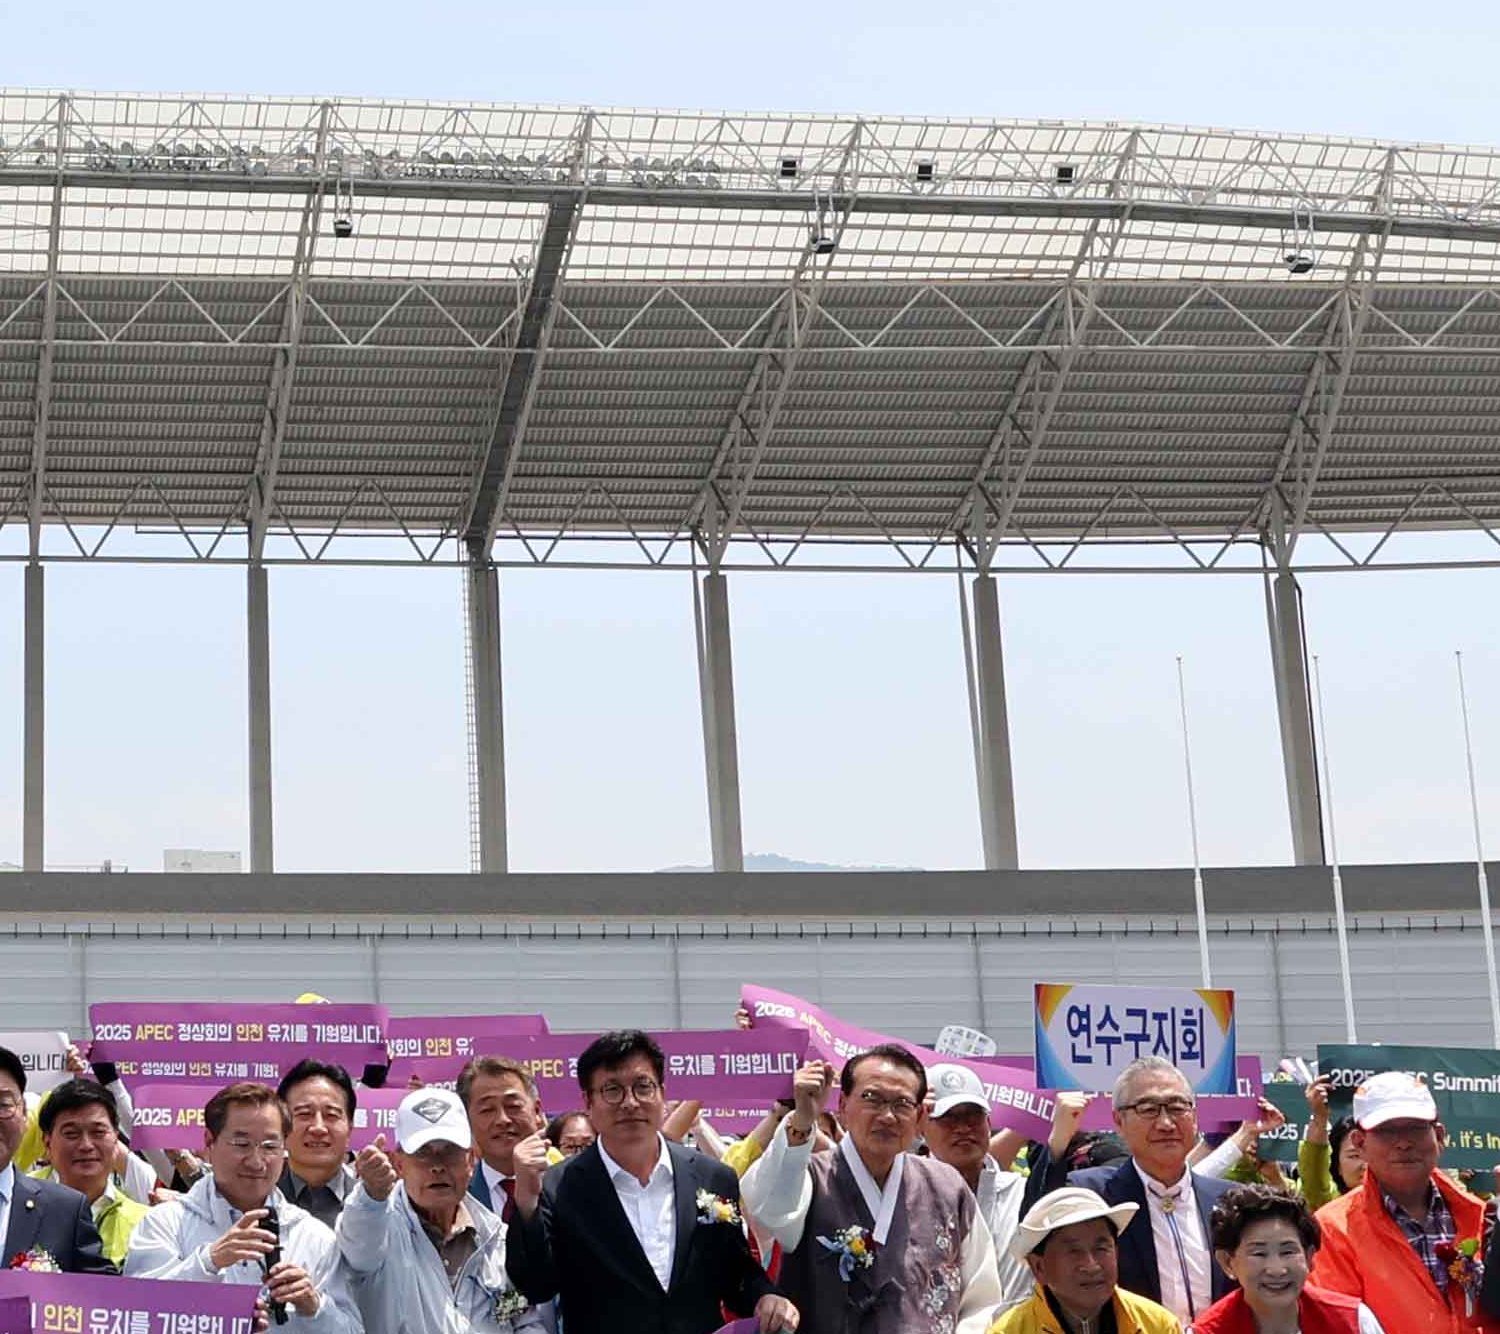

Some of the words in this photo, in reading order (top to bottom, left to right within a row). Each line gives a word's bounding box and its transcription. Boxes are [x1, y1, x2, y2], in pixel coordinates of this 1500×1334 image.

[754, 1002, 795, 1018] 2025
[95, 1025, 131, 1040] 2025
[135, 1024, 173, 1040] APEC
[178, 1023, 232, 1042] 정상회의
[236, 1024, 263, 1042] 인천
[267, 1024, 308, 1042] 유치를
[1066, 1003, 1206, 1069] 연수구지회
[425, 1038, 451, 1056] 인천
[669, 1054, 716, 1076] 유치를
[133, 1109, 172, 1126] 2025
[1461, 1130, 1483, 1148] it's
[44, 1304, 83, 1333] 인천
